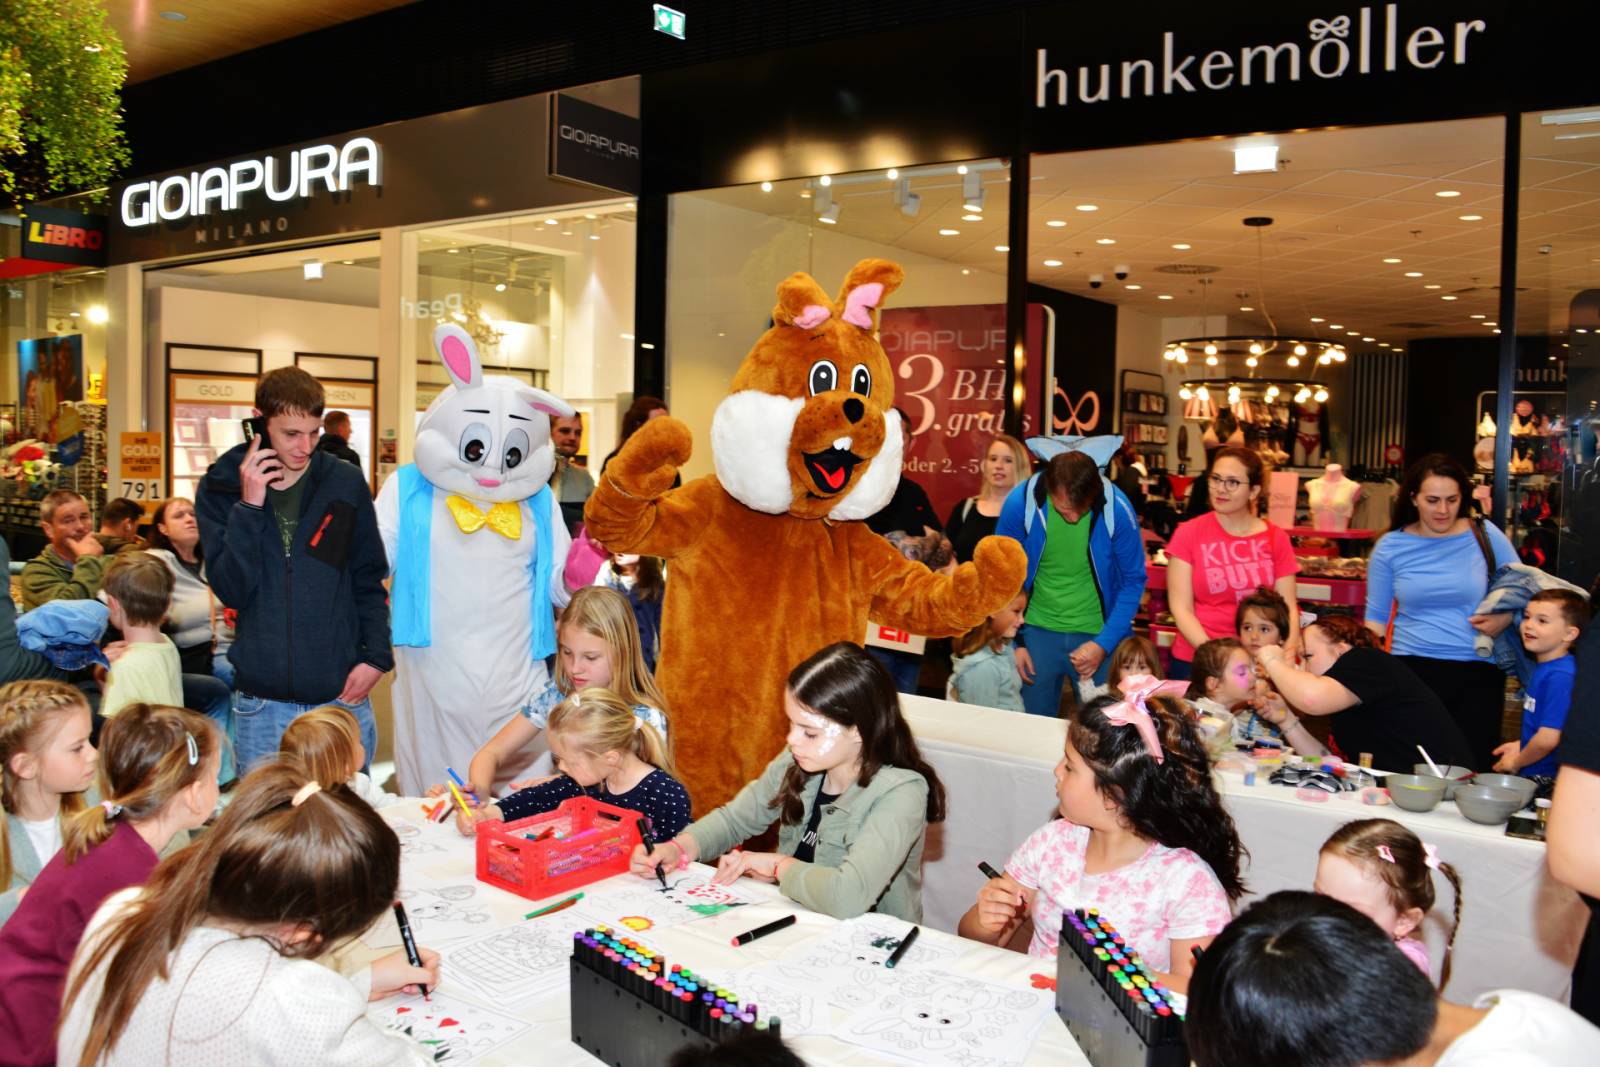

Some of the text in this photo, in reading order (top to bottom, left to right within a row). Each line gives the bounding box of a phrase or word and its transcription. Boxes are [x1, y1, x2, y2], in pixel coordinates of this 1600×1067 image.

[560, 125, 640, 160] GIOIAPURA
[121, 136, 381, 227] GIOIAPURA
[195, 216, 289, 244] MILANO
[199, 384, 234, 397] GOLD
[945, 409, 1032, 438] grats
[122, 444, 161, 457] GOLD
[1200, 539, 1272, 567] KICK
[1206, 559, 1274, 595] BUTT
